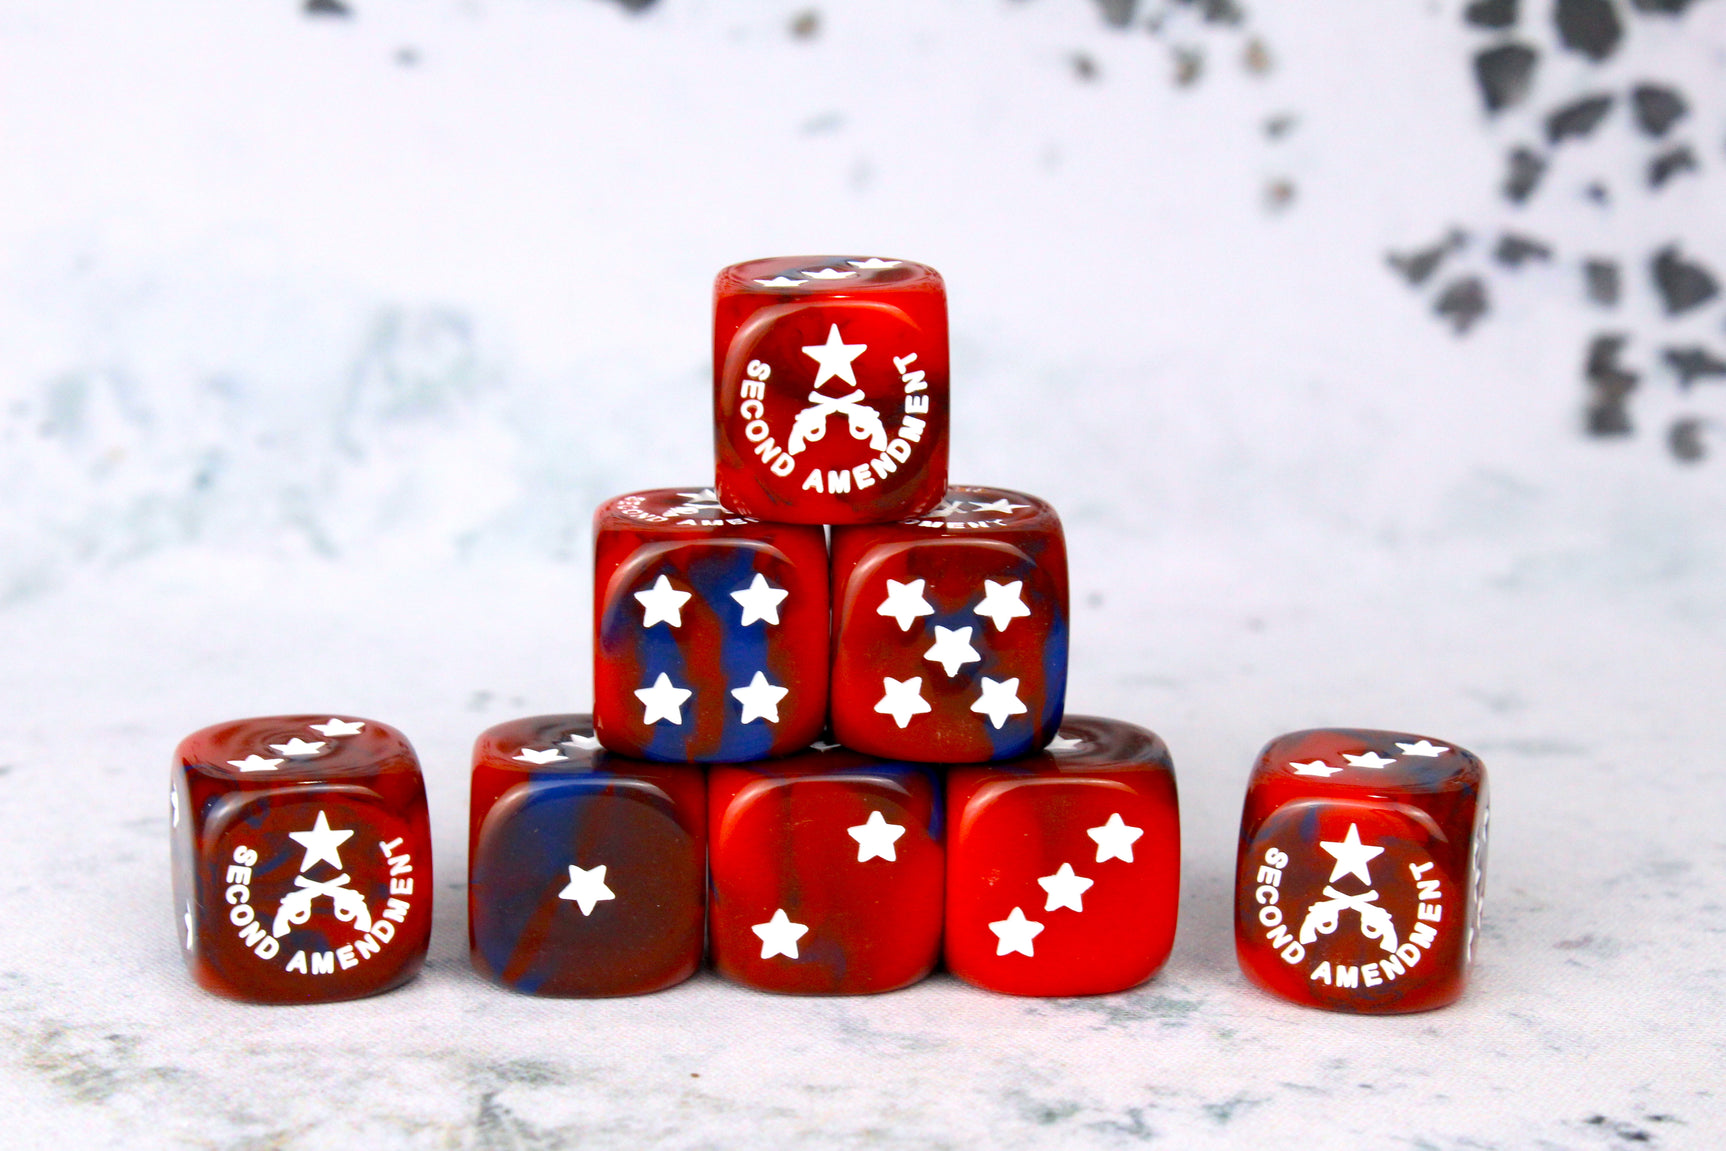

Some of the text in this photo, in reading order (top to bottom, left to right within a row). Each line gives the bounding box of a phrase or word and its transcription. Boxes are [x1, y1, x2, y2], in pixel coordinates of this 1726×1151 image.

[740, 352, 929, 494] SECOND AMENDMENT
[225, 837, 414, 975] SECOND AMENDMENT
[1255, 847, 1442, 988] SECOND AMENDMENT
